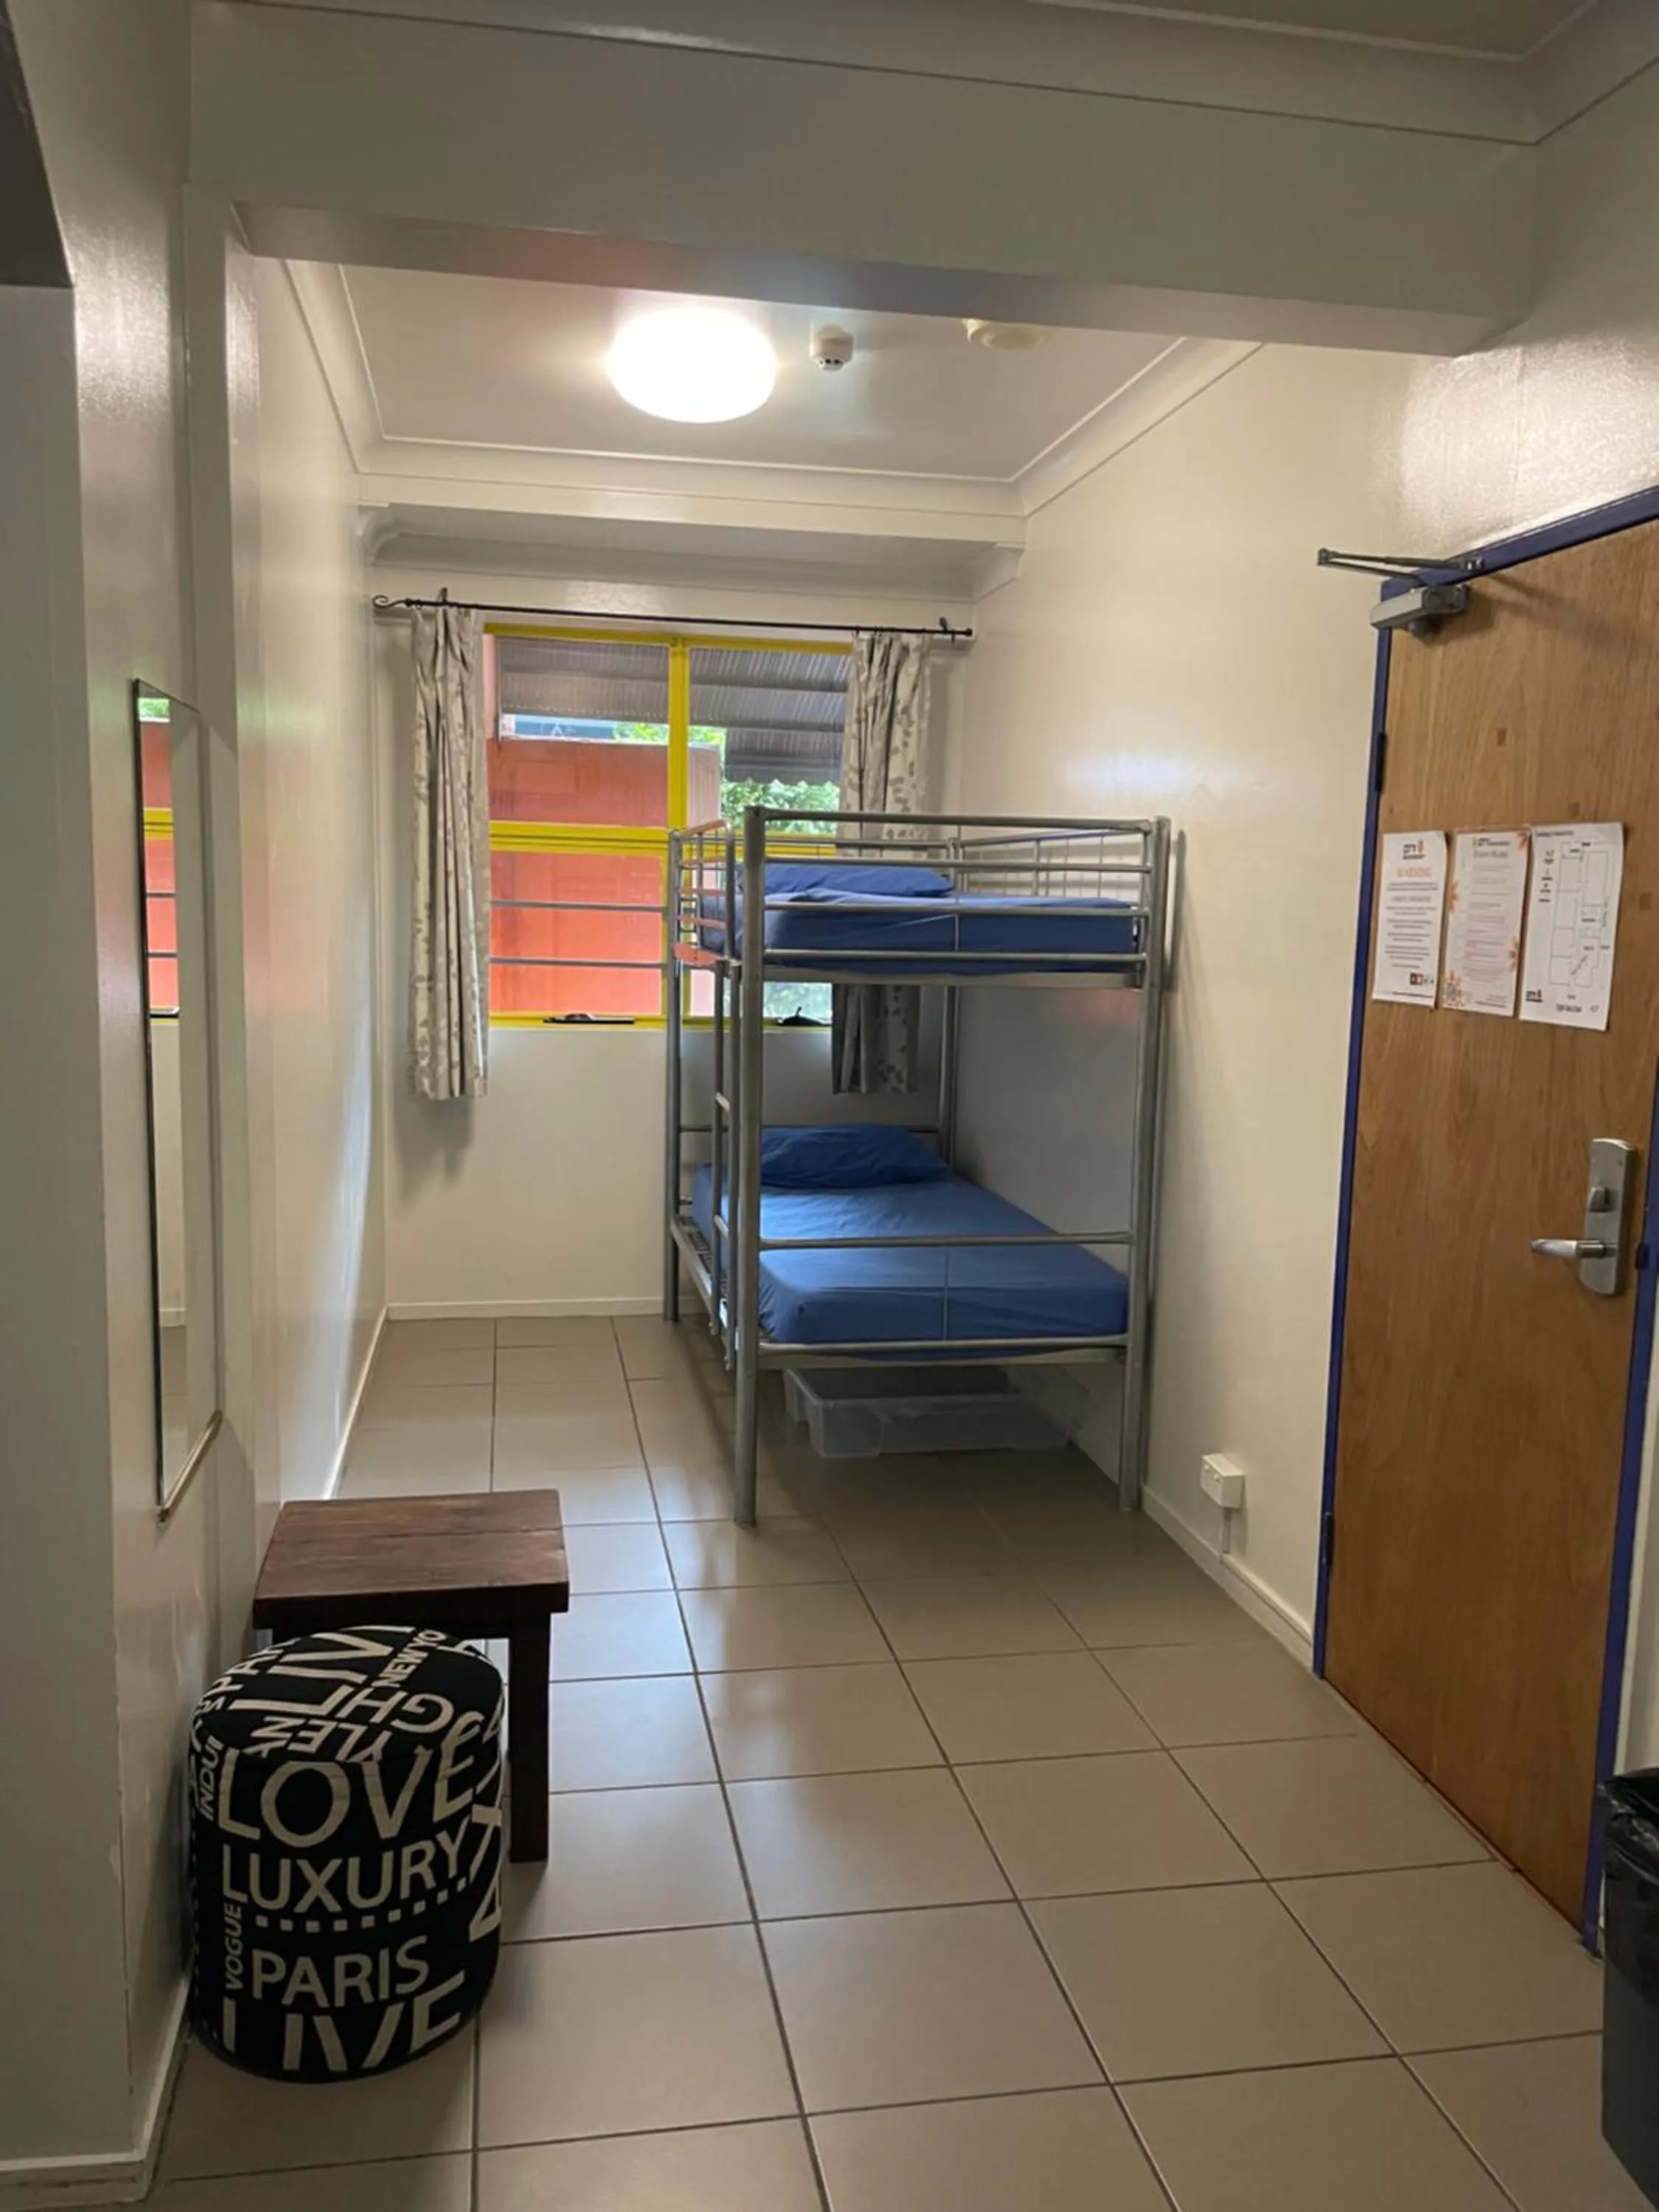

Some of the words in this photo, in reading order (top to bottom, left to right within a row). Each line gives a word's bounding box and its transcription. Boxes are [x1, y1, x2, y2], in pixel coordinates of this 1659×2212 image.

[218, 1714, 479, 1848] LOVE
[223, 1818, 468, 1914] LUXURY
[223, 1900, 245, 1990] VOGUE
[251, 1935, 429, 2008] PARIS
